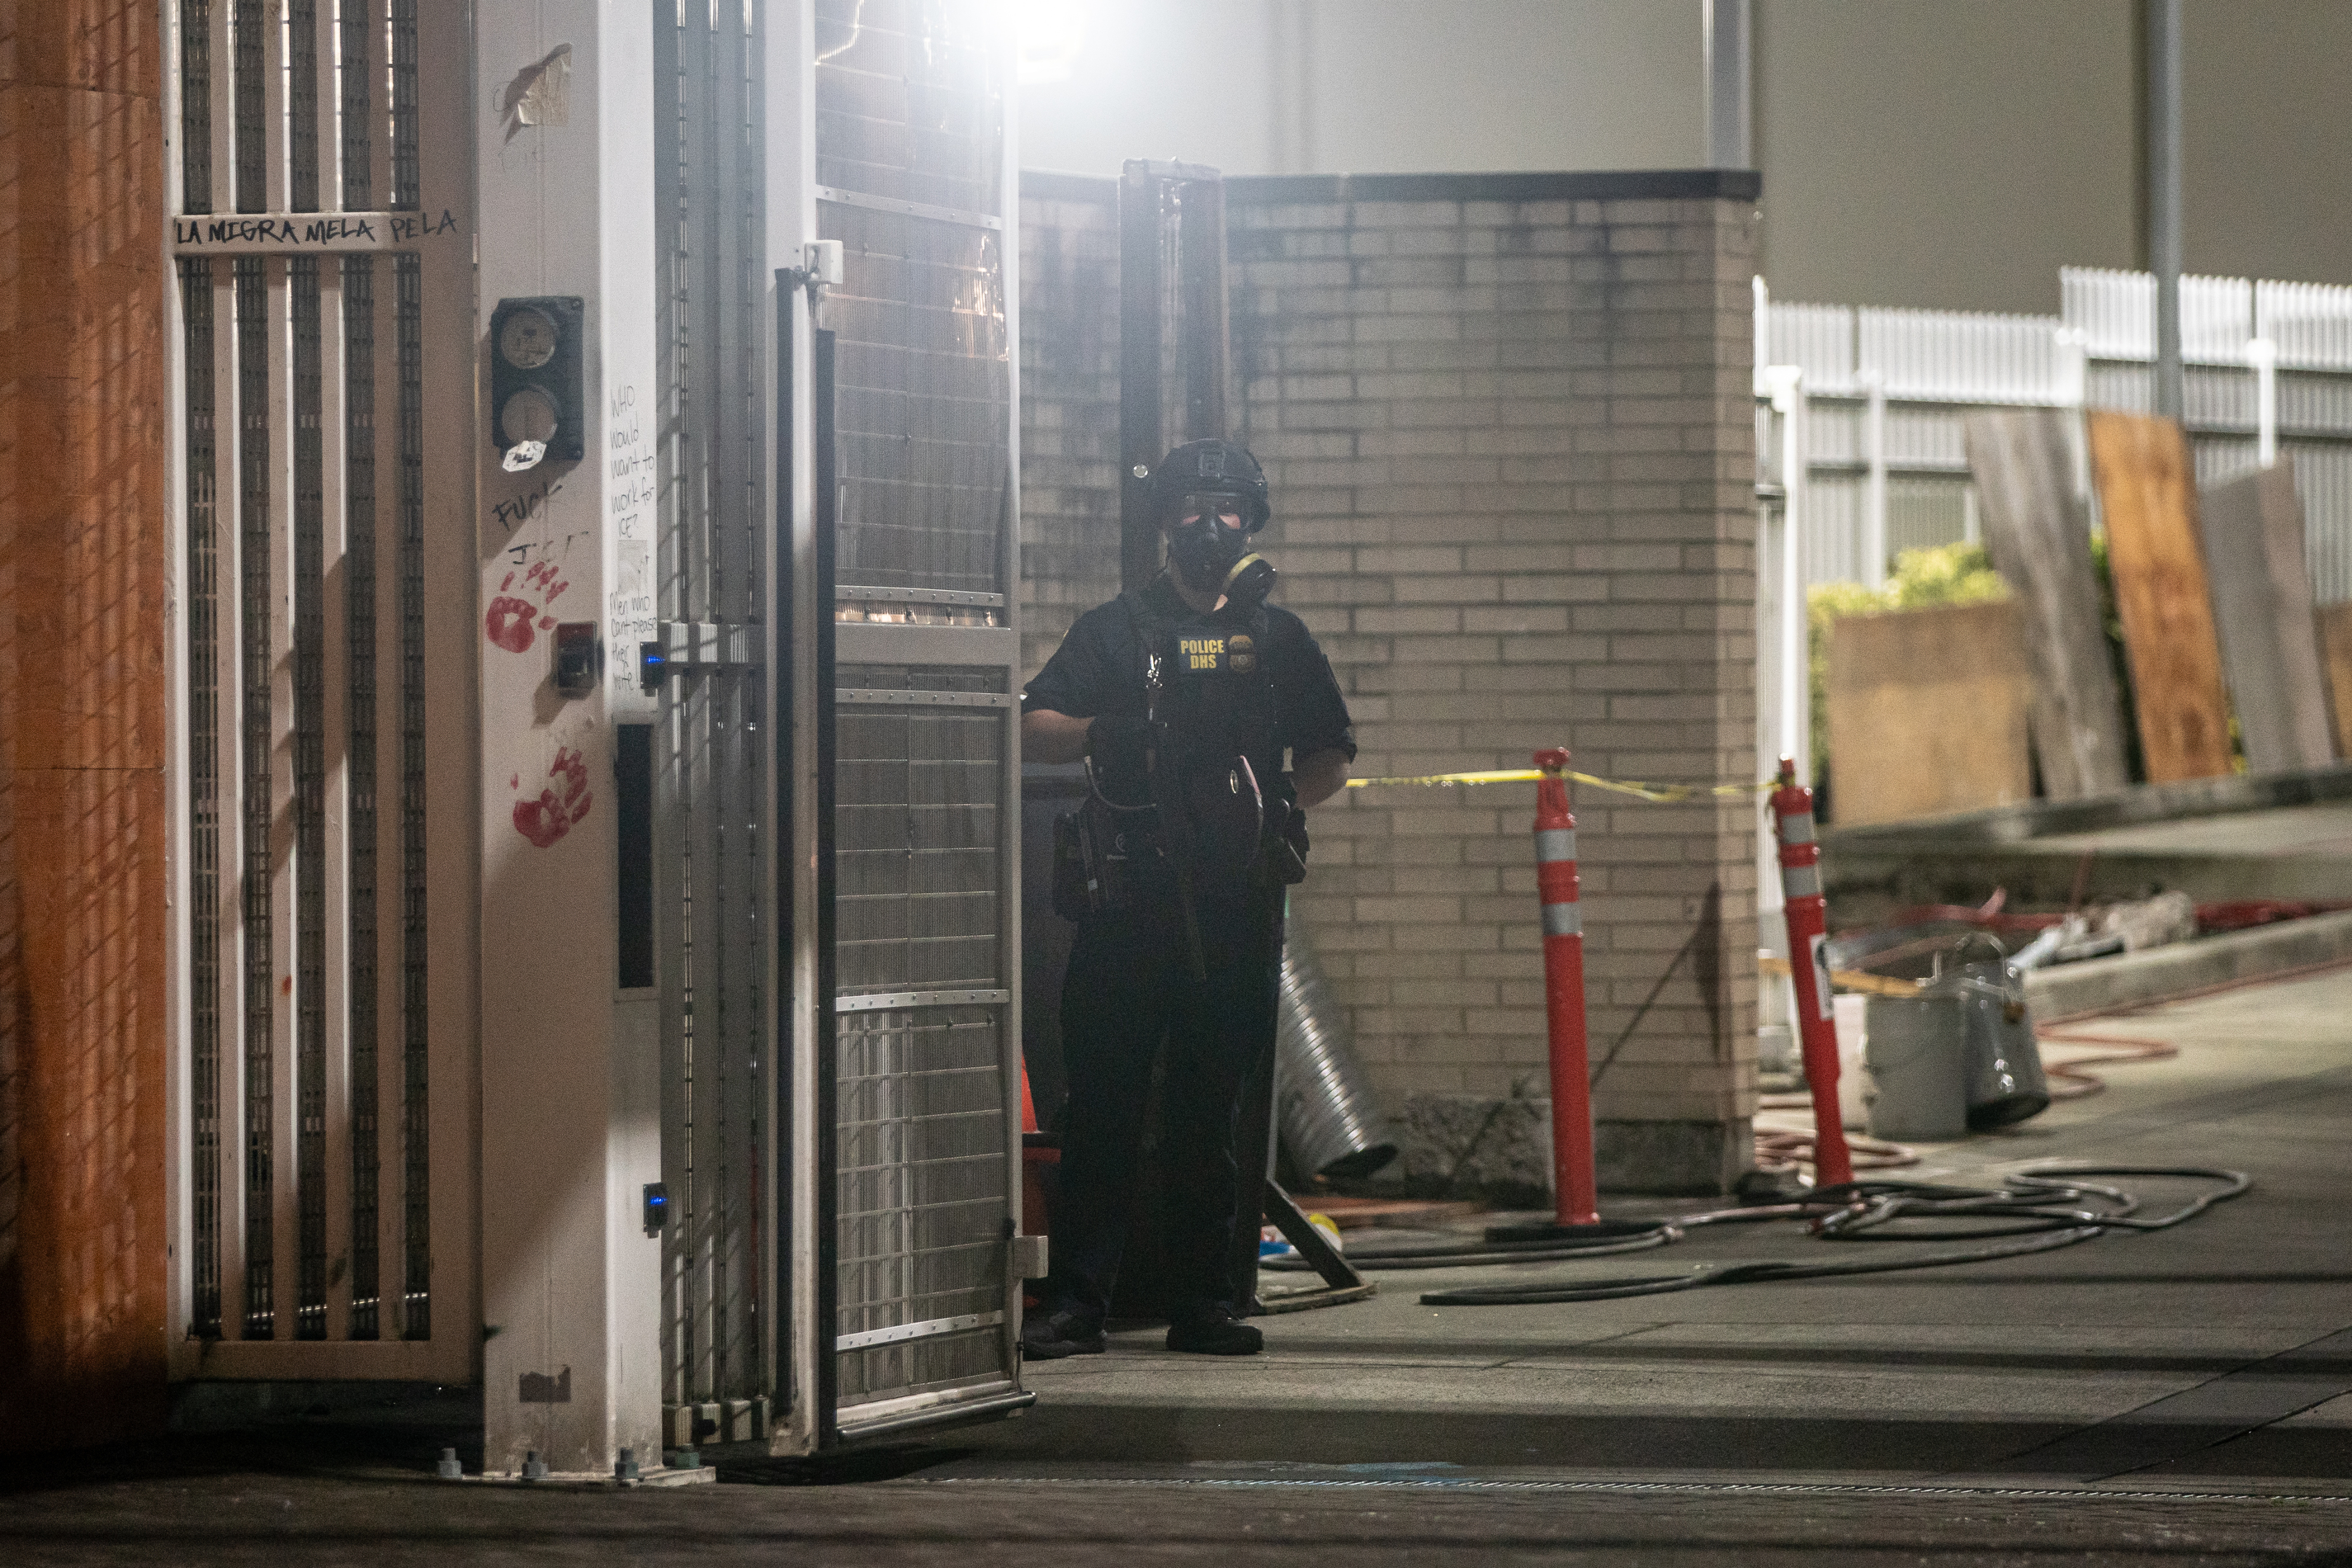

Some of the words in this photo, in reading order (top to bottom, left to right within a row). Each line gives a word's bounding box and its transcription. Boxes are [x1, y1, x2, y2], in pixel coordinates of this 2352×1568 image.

[177, 220, 202, 244] LA
[208, 218, 300, 244] MIGRA
[305, 218, 376, 245] MELA
[390, 209, 458, 243] PELA
[611, 384, 635, 418] WHO
[642, 443, 655, 472] to
[641, 475, 655, 506] for
[618, 513, 639, 538] ICE?
[1180, 640, 1225, 654] POLICE
[1190, 654, 1217, 669] DHS
